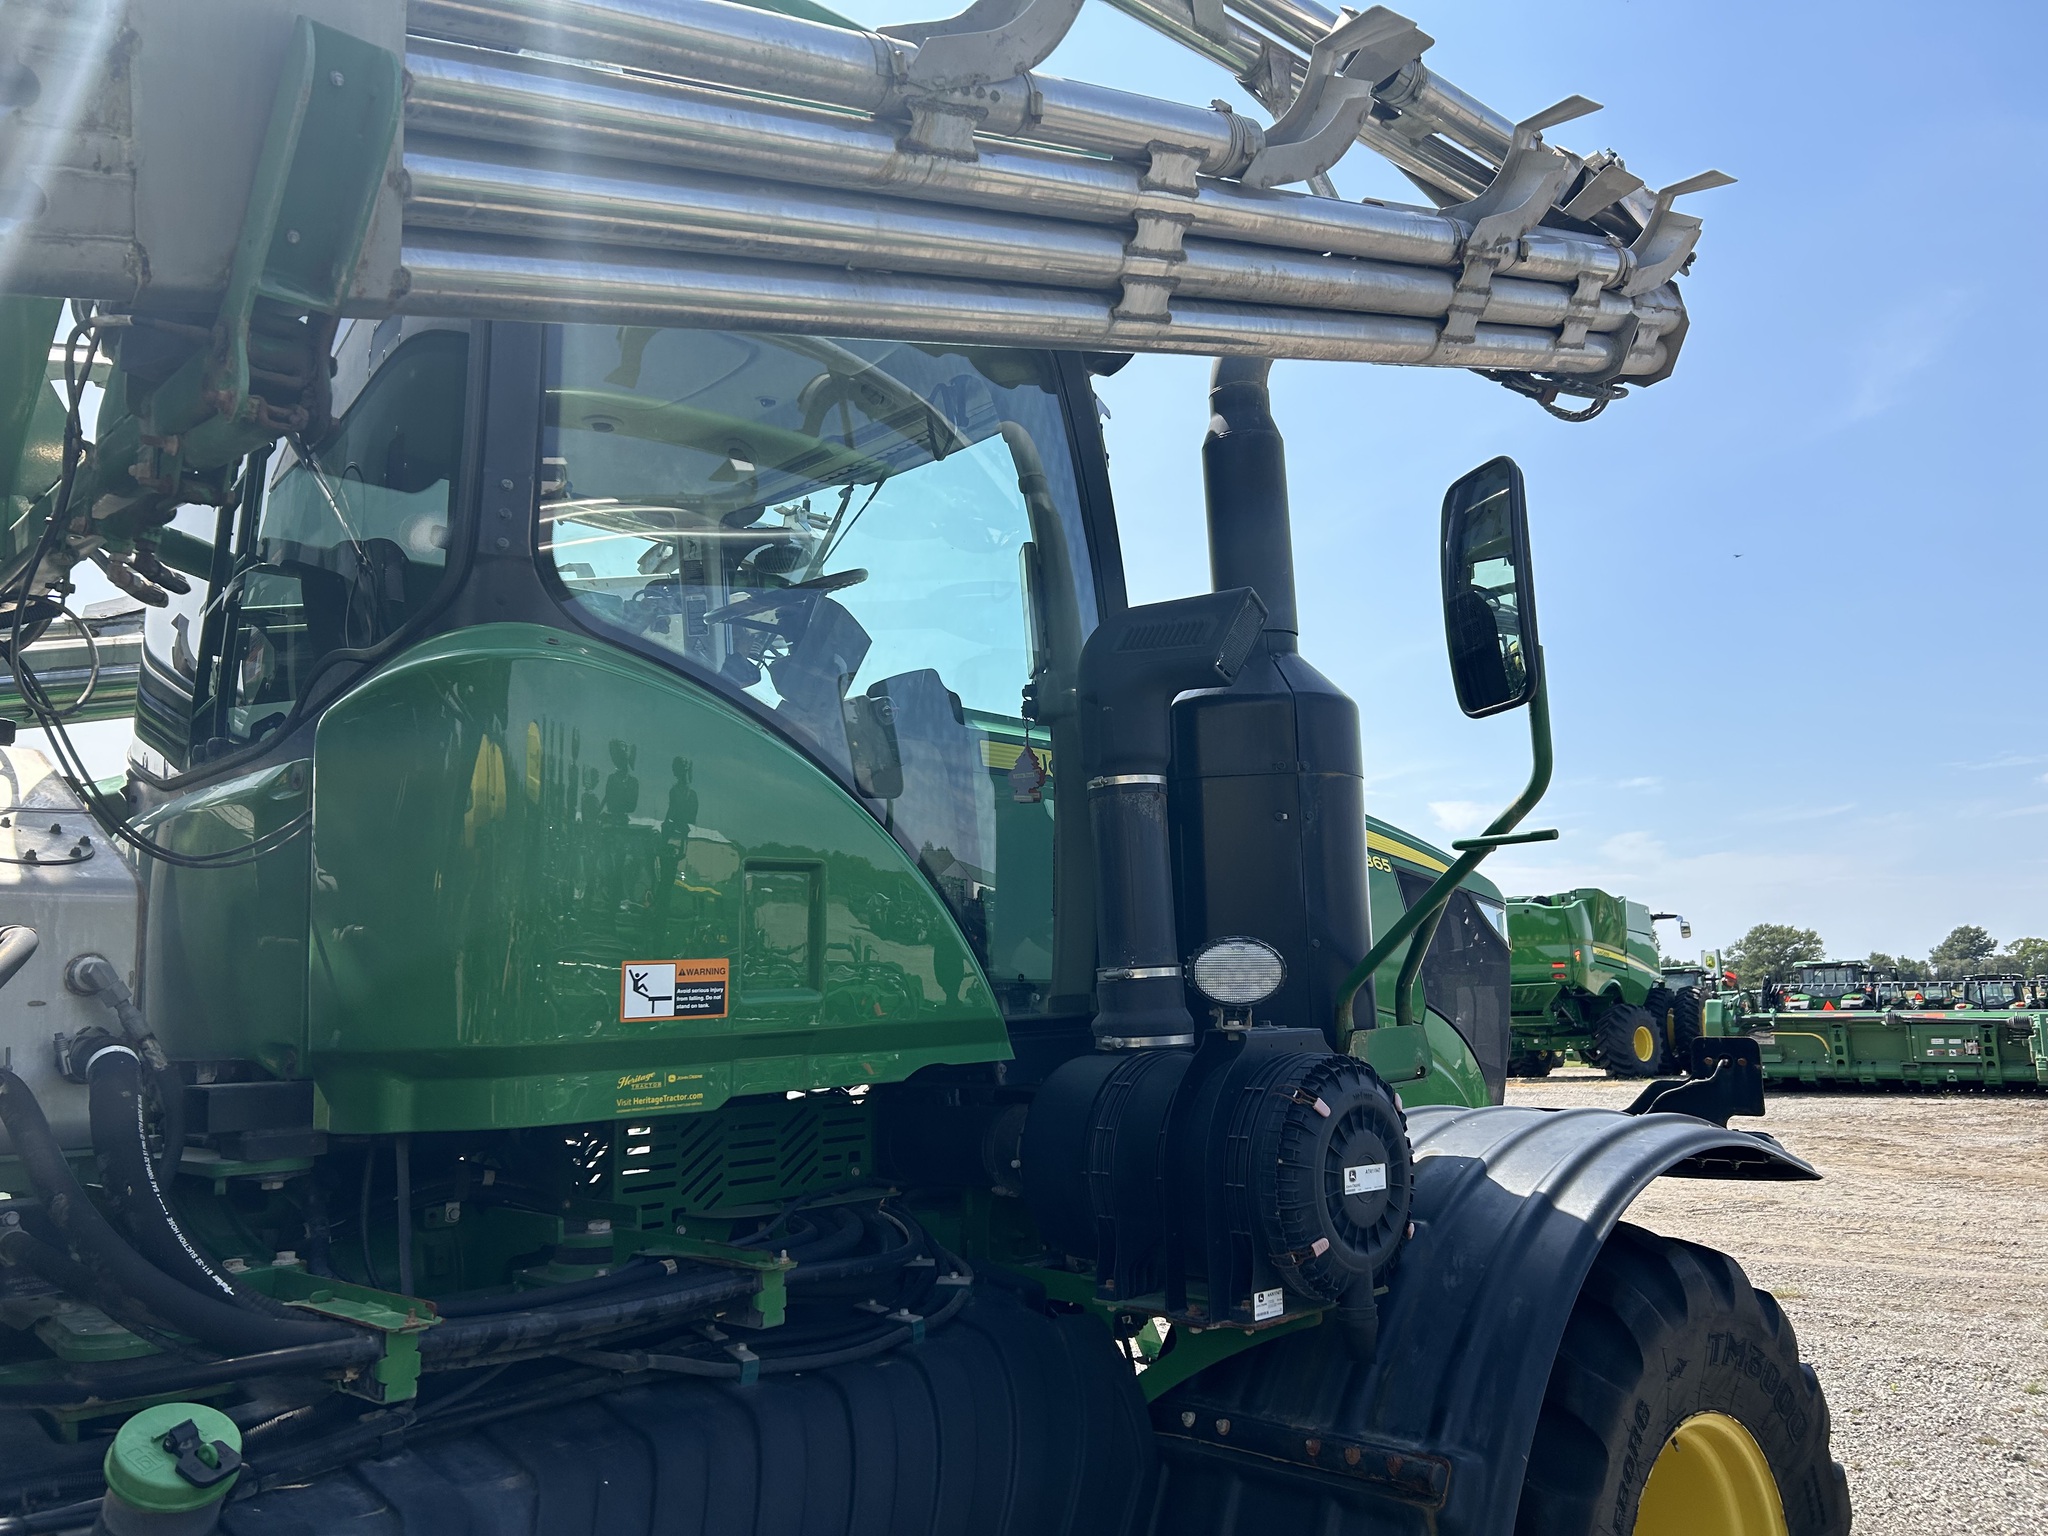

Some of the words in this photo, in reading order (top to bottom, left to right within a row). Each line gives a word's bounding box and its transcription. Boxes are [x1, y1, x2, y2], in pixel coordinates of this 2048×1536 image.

[686, 968, 726, 976] WARNING
[617, 1072, 656, 1089] Heritage
[631, 1082, 662, 1090] TRACTOR
[633, 1093, 703, 1105] HeritageTractor.com
[151, 1180, 160, 1193] SAE
[166, 1217, 180, 1234] HOSE
[177, 1233, 198, 1260] SUCTION
[1708, 1332, 1807, 1445] TM3000
